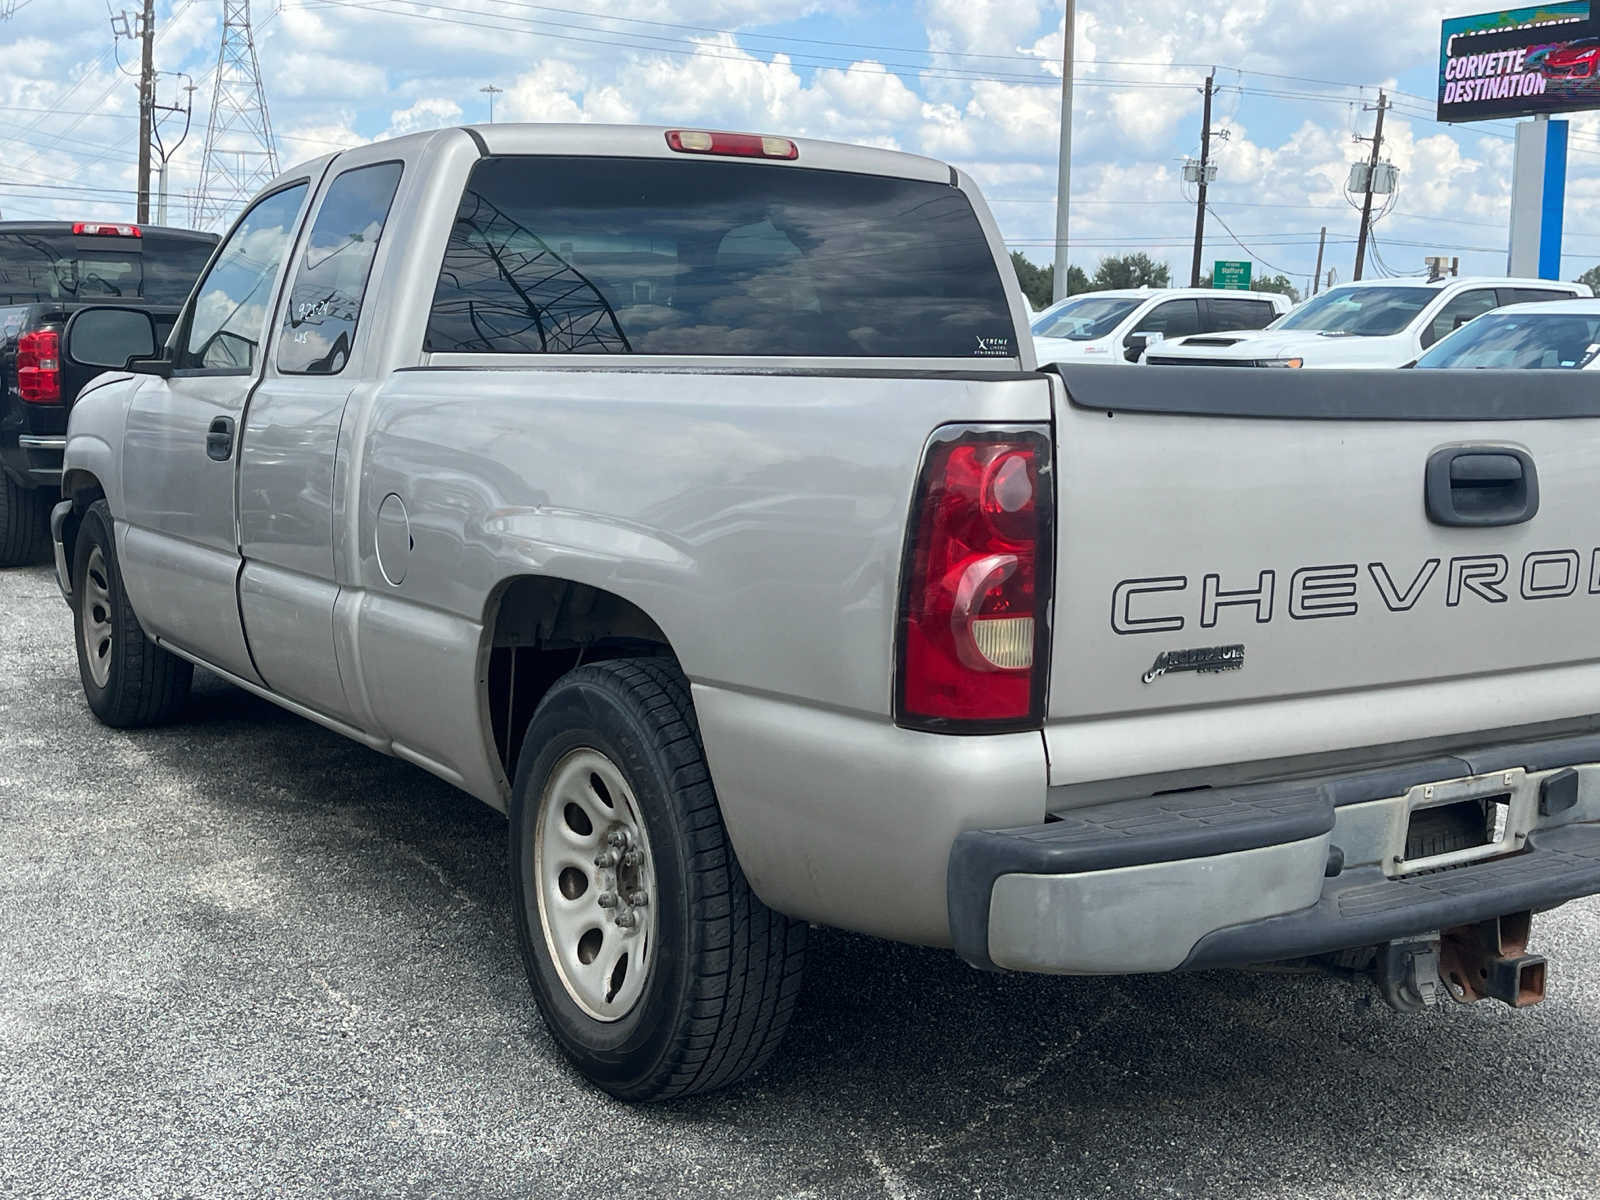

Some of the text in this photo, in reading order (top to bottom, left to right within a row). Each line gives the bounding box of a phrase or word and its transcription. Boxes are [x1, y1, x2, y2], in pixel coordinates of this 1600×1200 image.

[1445, 49, 1527, 80] CORVETTE
[1443, 72, 1547, 104] DESTINATION
[1110, 547, 1600, 635] CHEVRO
